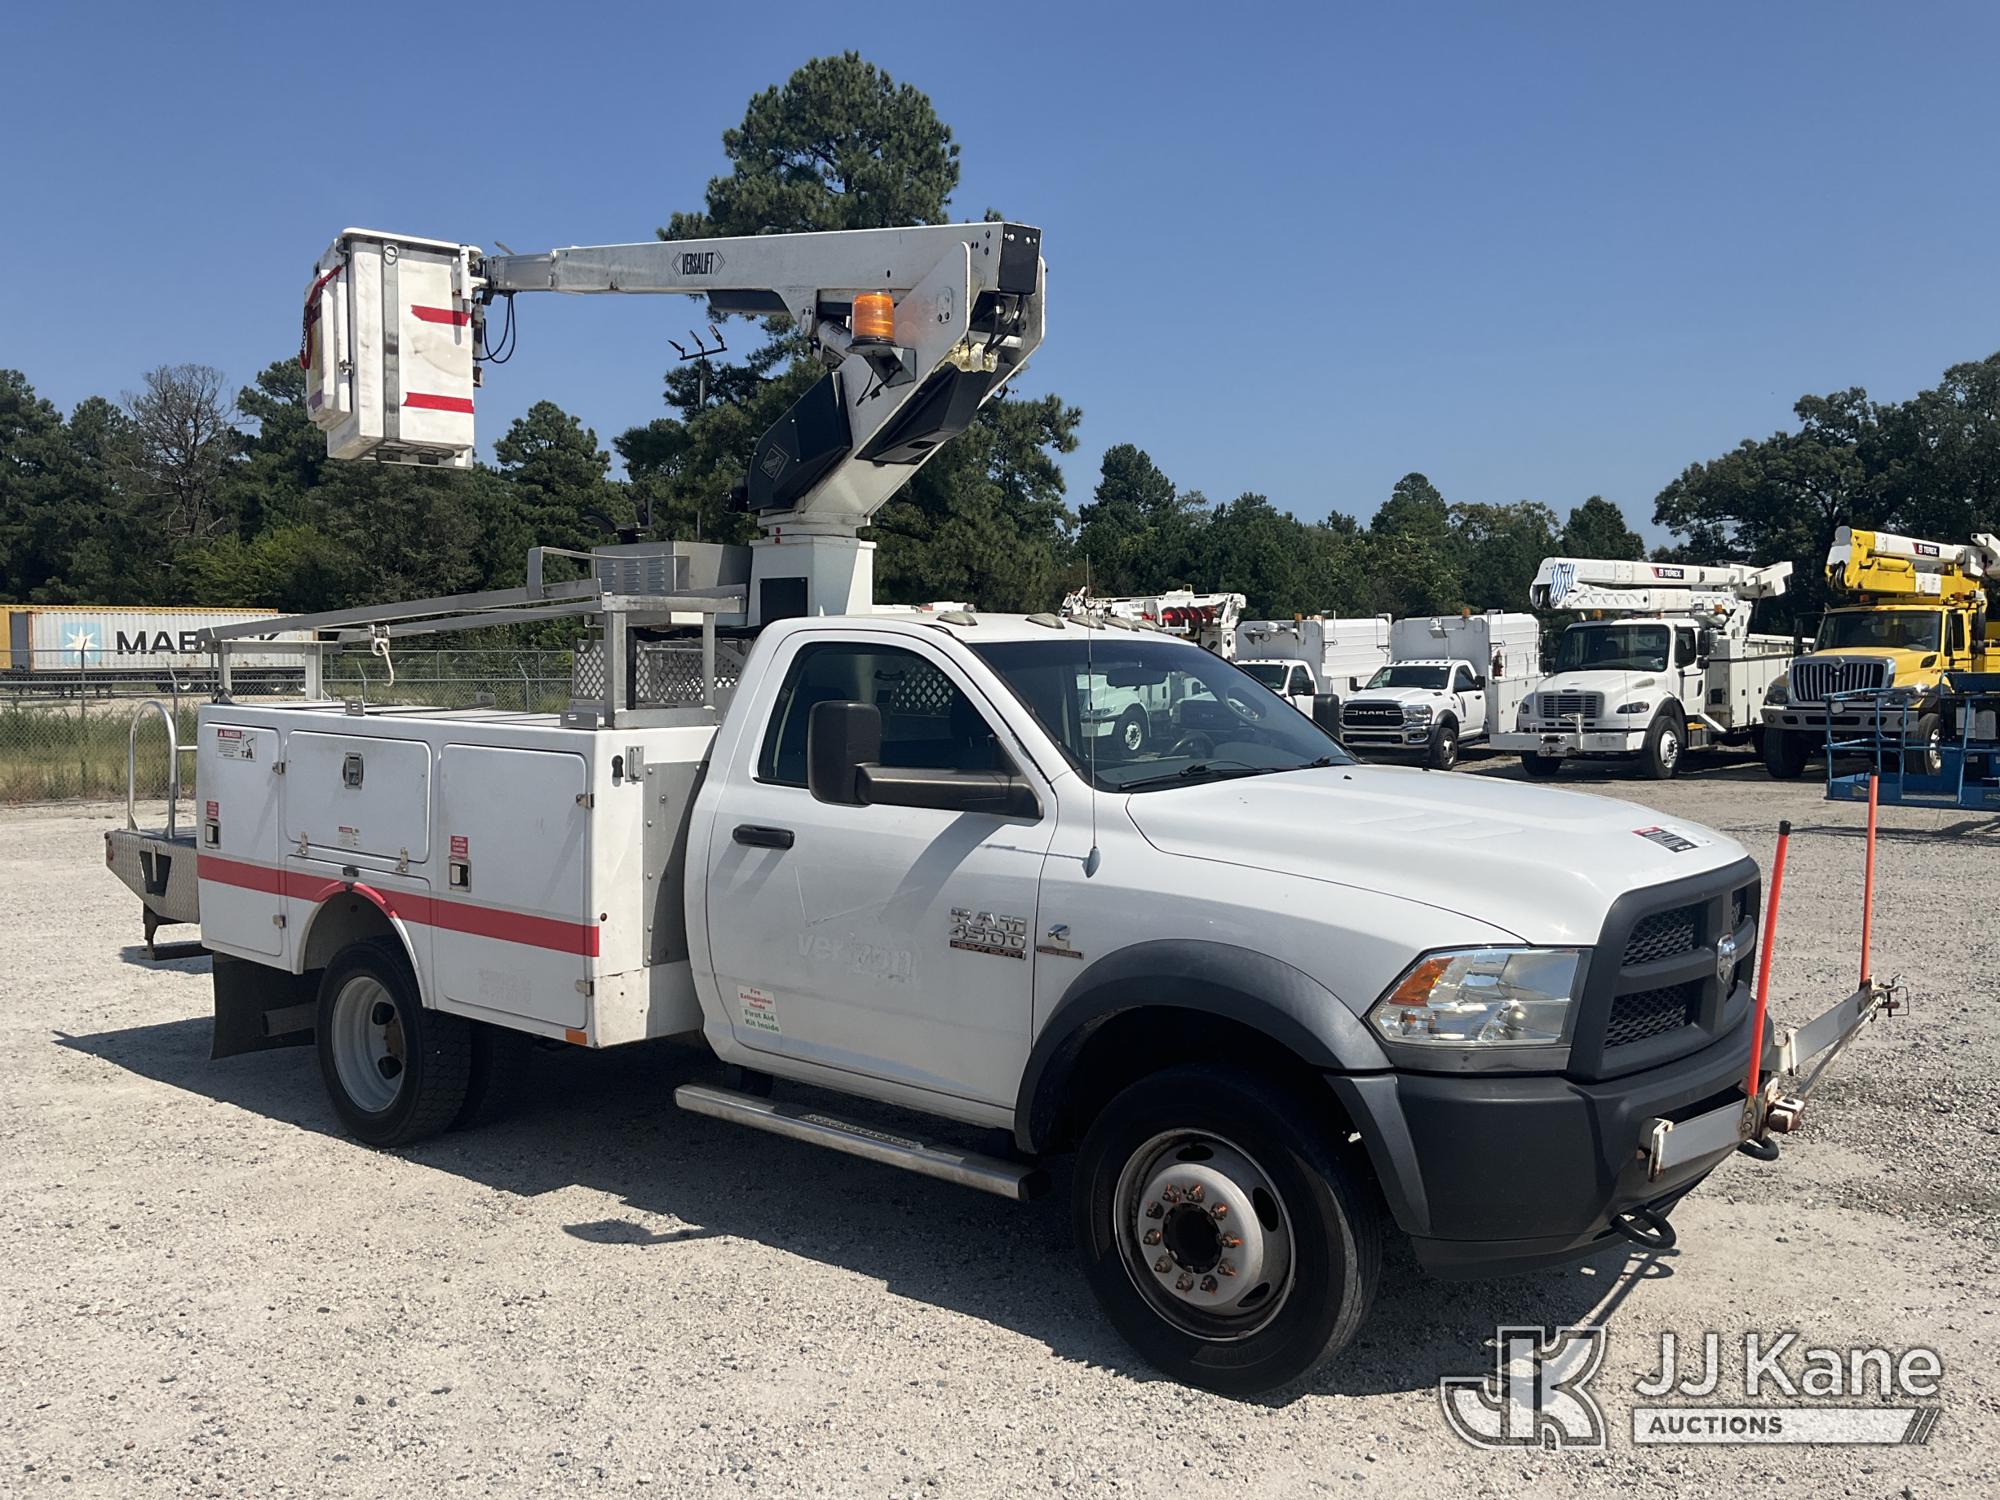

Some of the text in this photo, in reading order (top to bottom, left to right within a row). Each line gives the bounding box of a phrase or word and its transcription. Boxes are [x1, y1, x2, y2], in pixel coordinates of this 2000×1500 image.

[682, 252, 714, 275] VERSALIFT
[1664, 569, 1683, 577] TEREX
[950, 906, 1026, 933] RAM
[948, 924, 1026, 949] 4500
[744, 1009, 775, 1022] First Aid
[745, 1019, 779, 1032] Kit Inside
